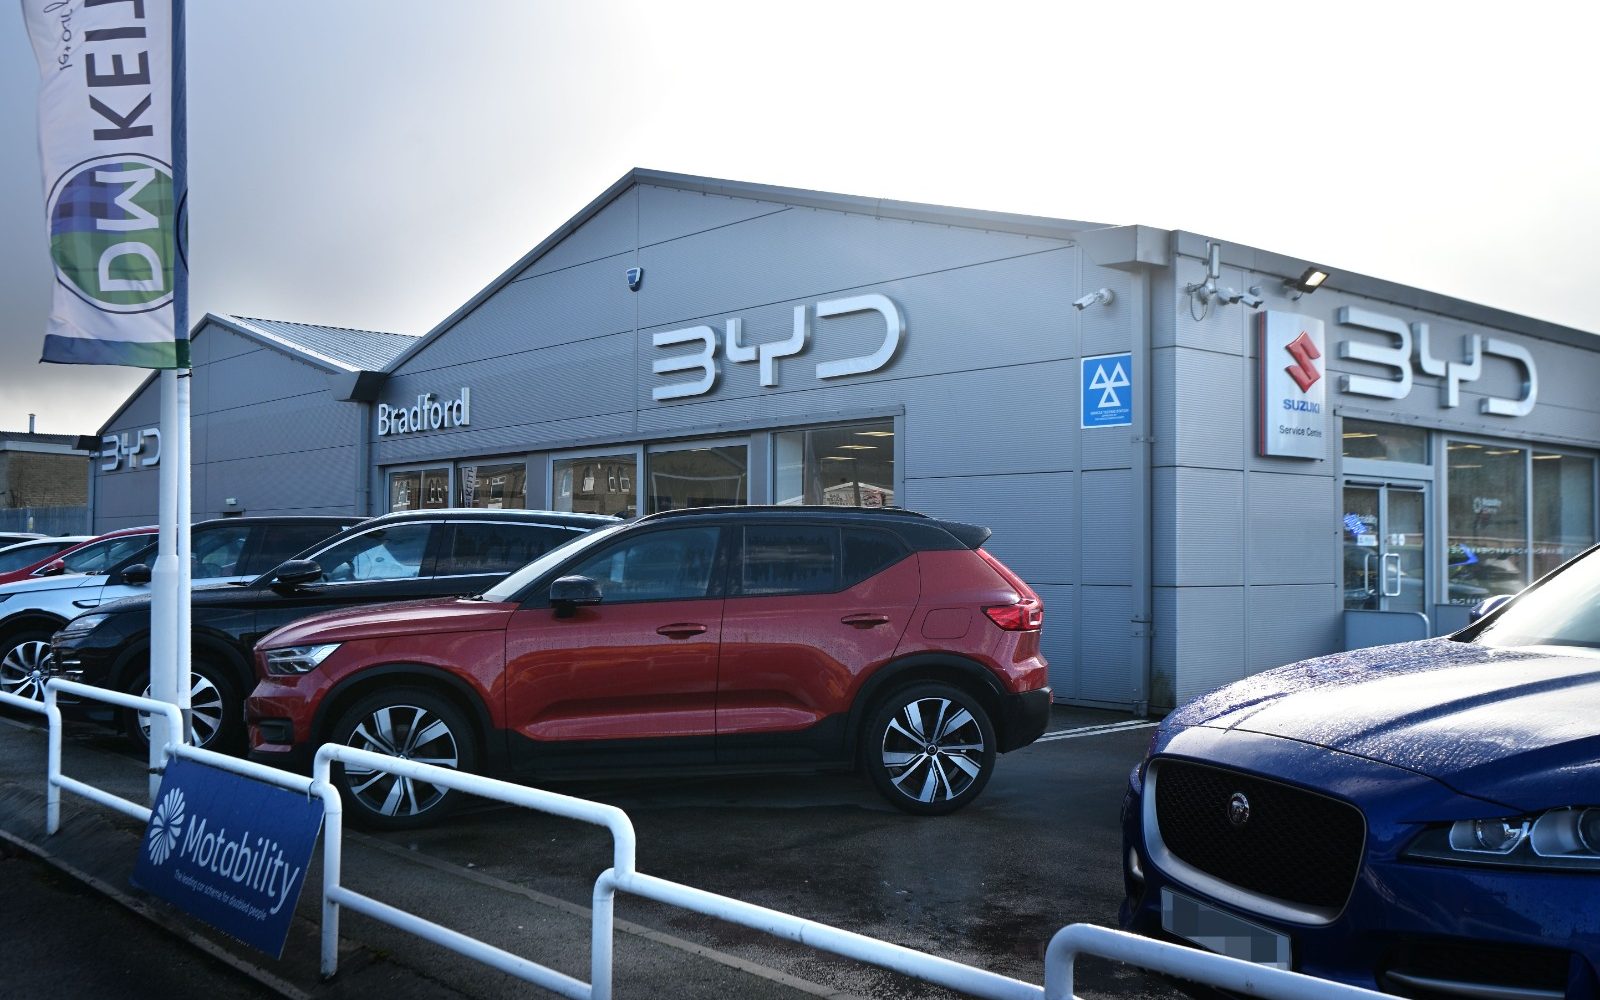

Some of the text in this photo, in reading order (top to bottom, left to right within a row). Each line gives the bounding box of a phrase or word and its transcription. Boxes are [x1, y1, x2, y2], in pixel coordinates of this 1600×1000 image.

[652, 293, 905, 400] BYD
[1338, 305, 1538, 417] BYD
[378, 387, 470, 436] Bradford
[1279, 424, 1305, 436] Service
[1283, 399, 1321, 414] SUZUKI
[101, 428, 161, 471] BYD
[179, 814, 300, 915] Motability
